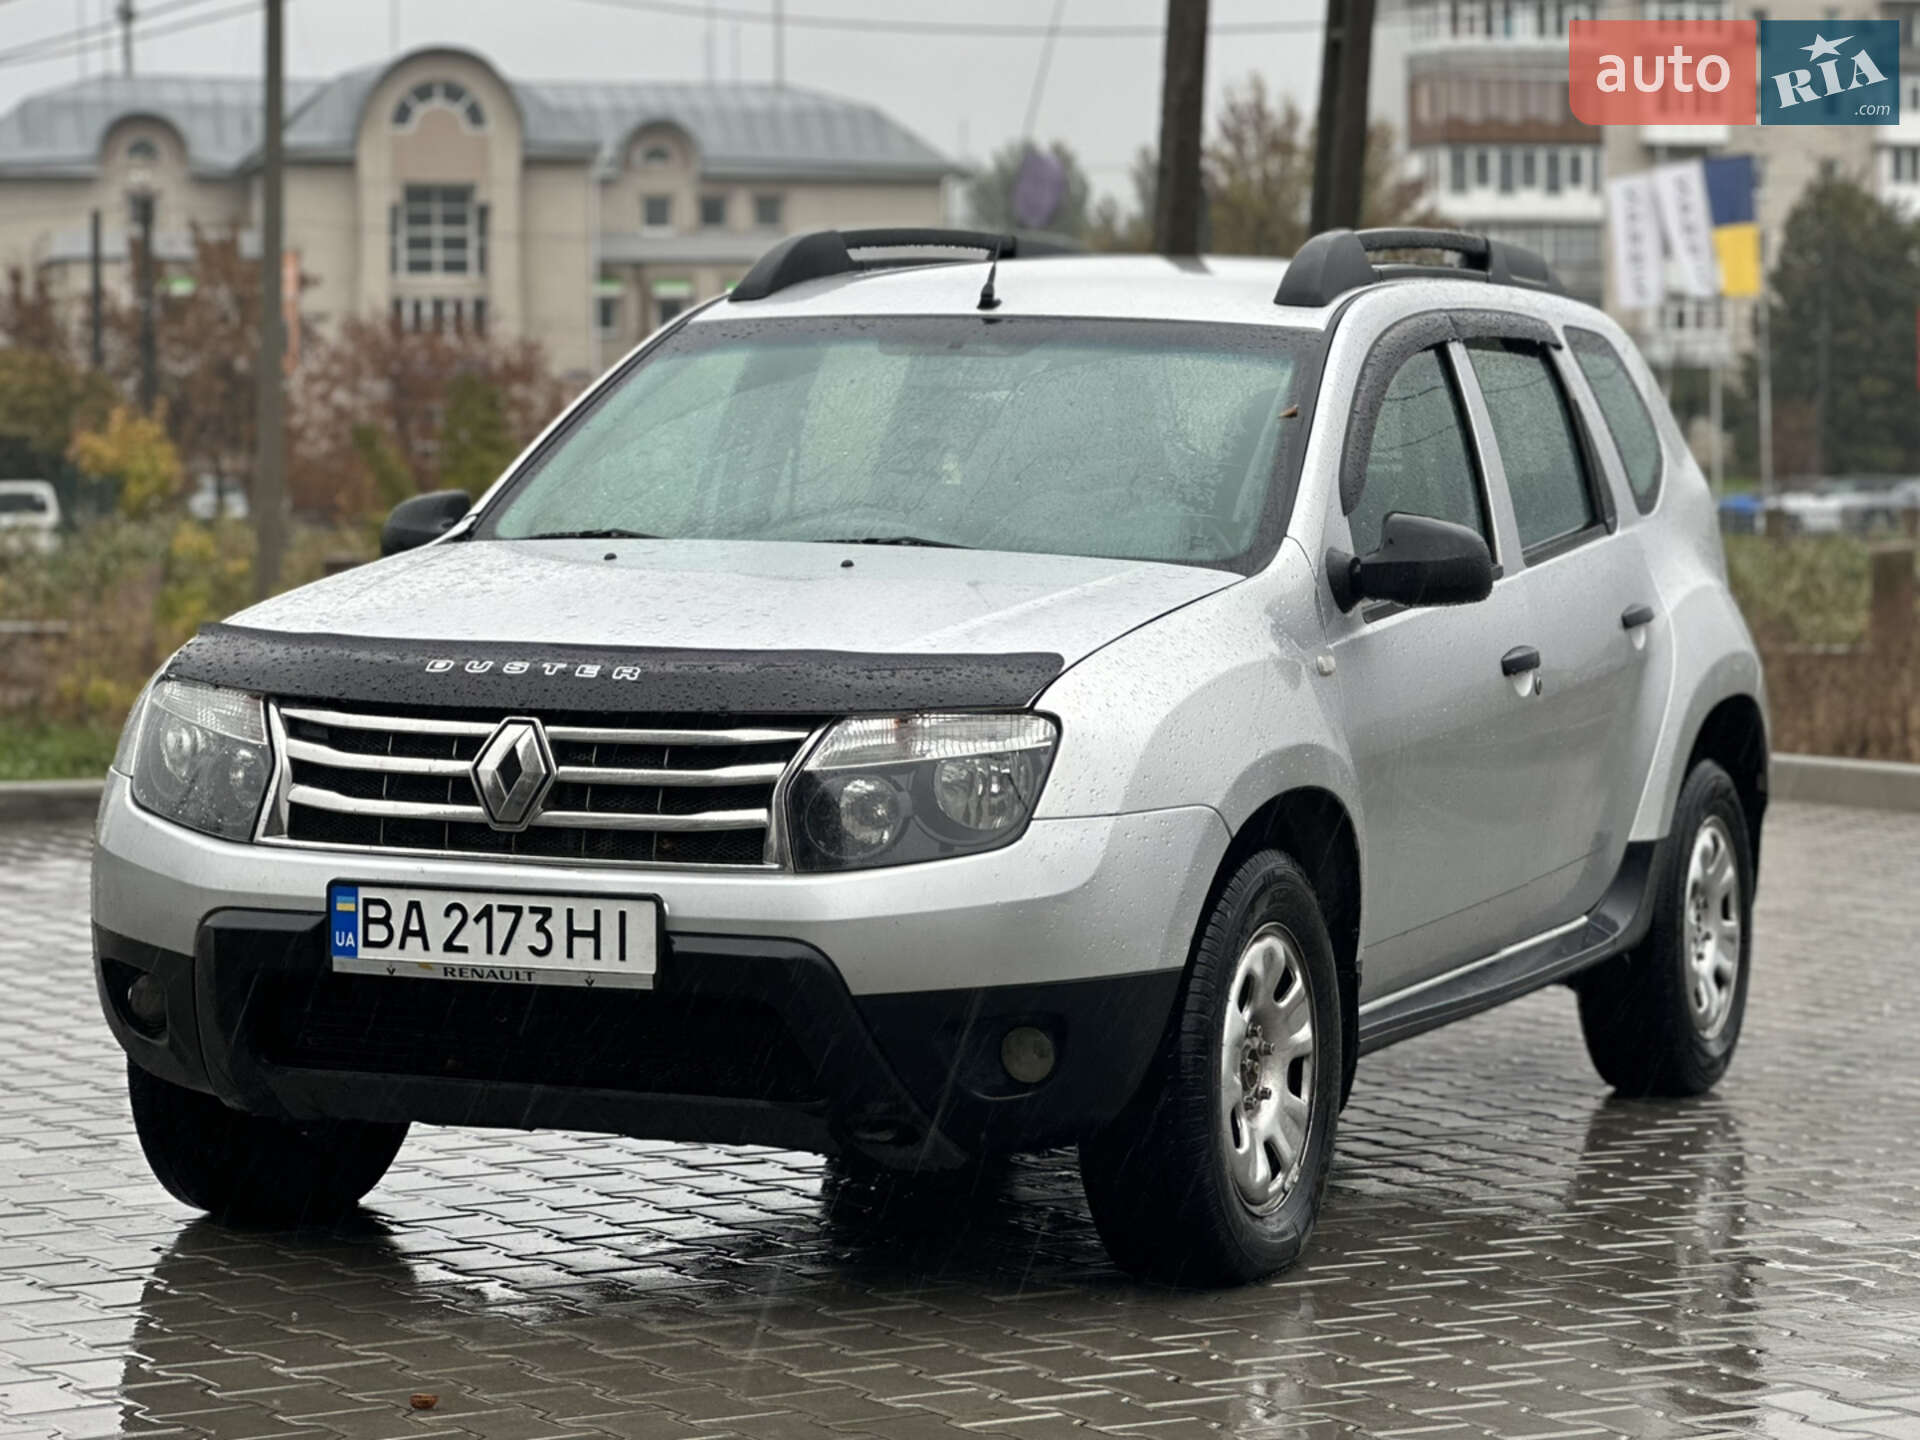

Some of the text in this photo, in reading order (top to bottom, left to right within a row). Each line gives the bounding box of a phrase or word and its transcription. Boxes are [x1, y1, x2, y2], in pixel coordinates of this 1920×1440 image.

[425, 659, 641, 681] DUSTER
[335, 930, 355, 947] UA
[443, 966, 536, 983] RENAULT
